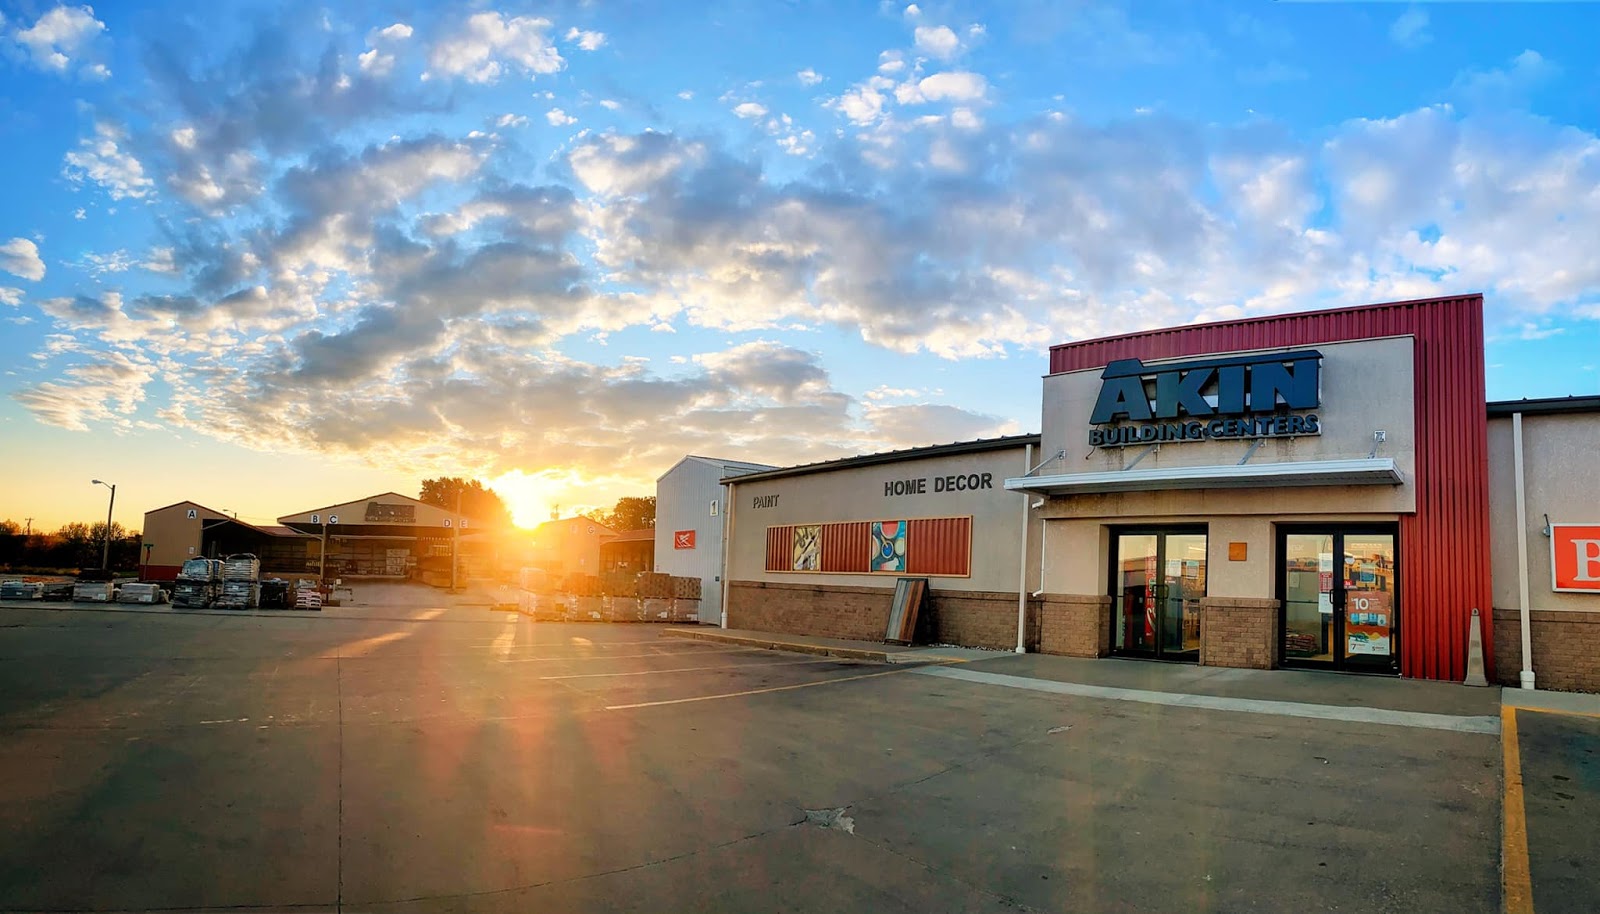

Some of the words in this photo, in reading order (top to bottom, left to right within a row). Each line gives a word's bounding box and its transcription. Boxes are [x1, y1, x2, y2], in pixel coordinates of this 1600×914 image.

[1090, 351, 1321, 424] AKIN
[1089, 420, 1203, 446] BUILDING
[1206, 414, 1319, 437] CENTERS
[884, 478, 926, 496] HOME
[934, 472, 993, 493] DECOR
[752, 494, 780, 509] PAINT
[711, 500, 717, 515] 1
[188, 509, 196, 519] A
[312, 515, 318, 523] B
[329, 515, 337, 524] C
[444, 519, 451, 527] D
[461, 519, 467, 528] E
[587, 526, 595, 534] G
